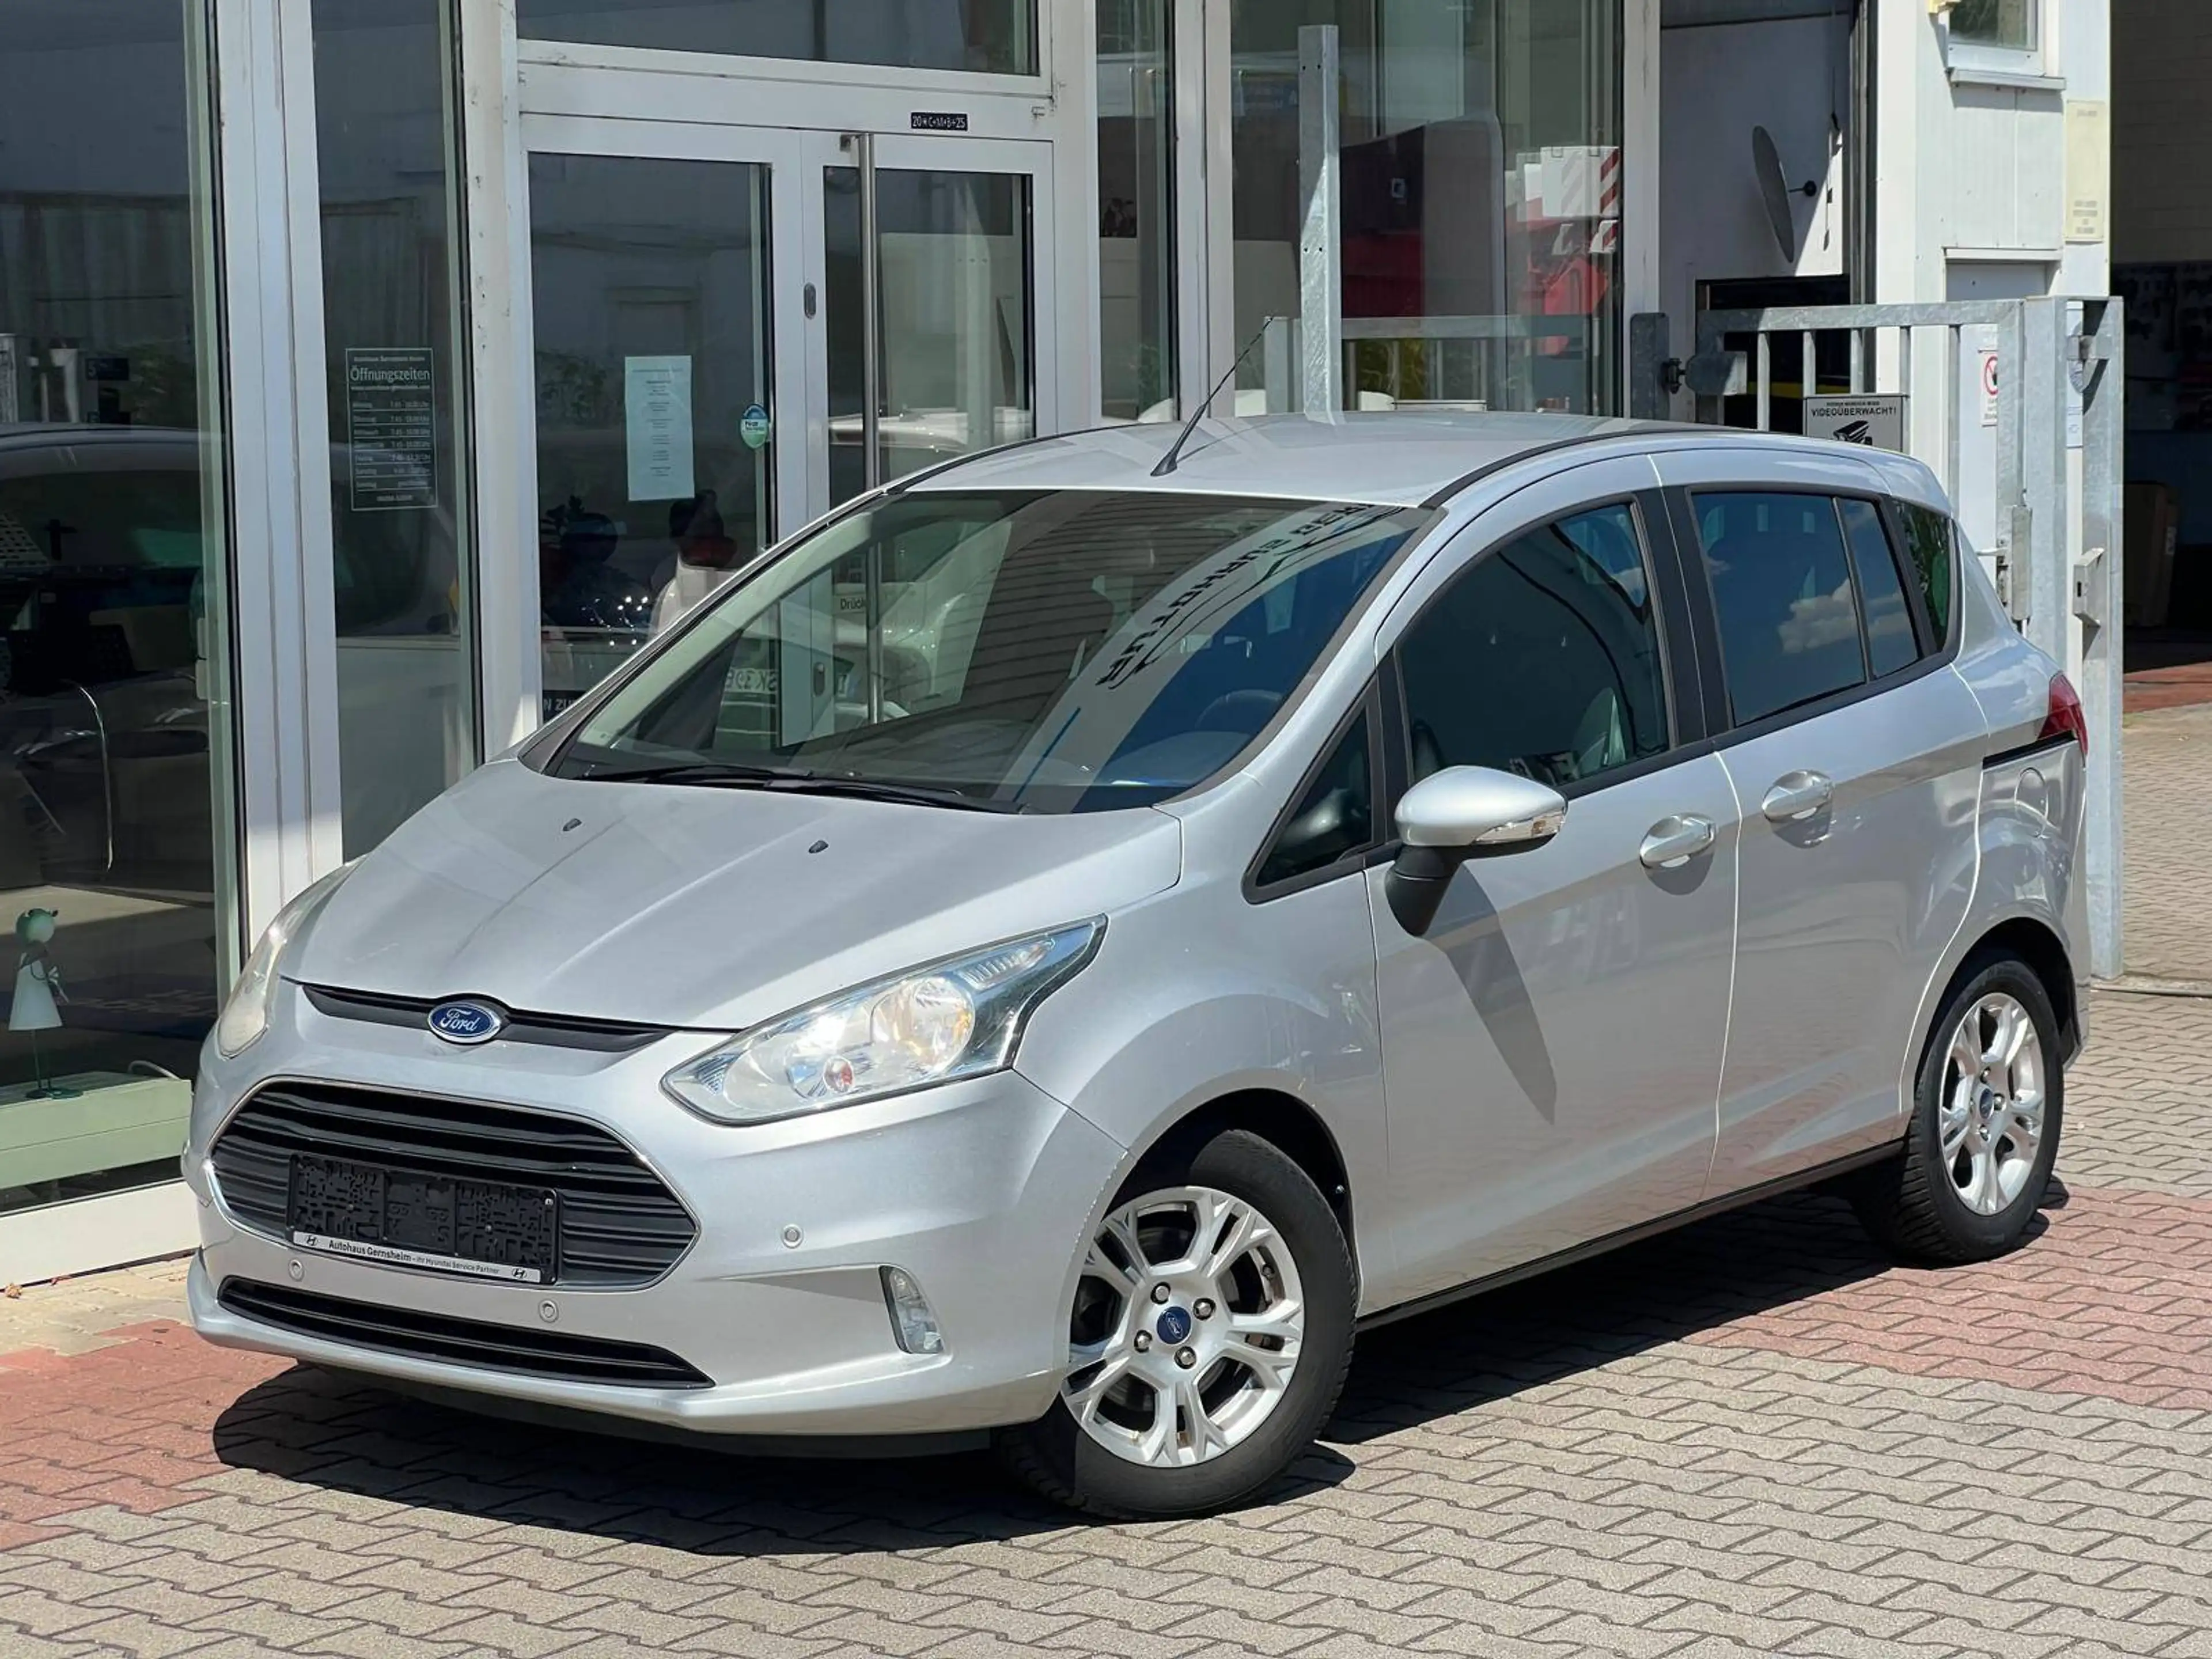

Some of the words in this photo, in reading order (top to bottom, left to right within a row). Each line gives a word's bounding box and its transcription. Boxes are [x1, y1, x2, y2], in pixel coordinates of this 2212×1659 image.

[350, 365, 430, 383] Öffnungszeiten
[440, 1008, 480, 1031] Ford
[329, 1240, 365, 1255] Autohaus
[366, 1247, 411, 1262] Gernsheim
